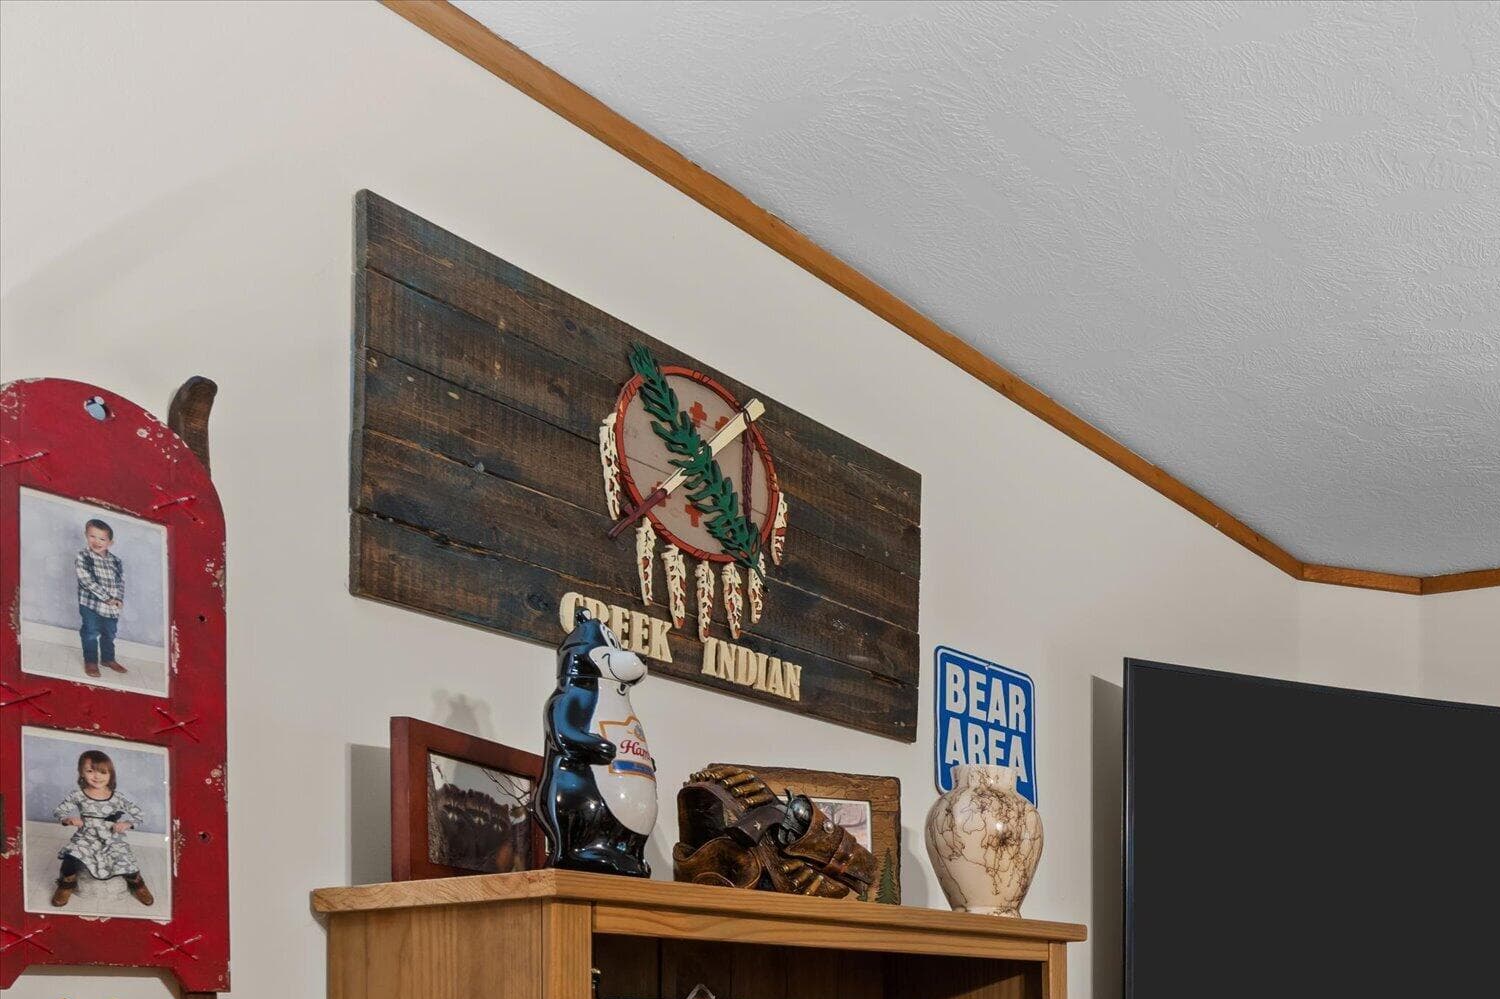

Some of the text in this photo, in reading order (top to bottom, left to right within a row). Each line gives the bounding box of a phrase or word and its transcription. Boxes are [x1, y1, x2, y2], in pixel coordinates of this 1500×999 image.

[701, 638, 801, 701] INDIAN
[945, 661, 1026, 733] BEAR
[944, 716, 1028, 783] AREA
